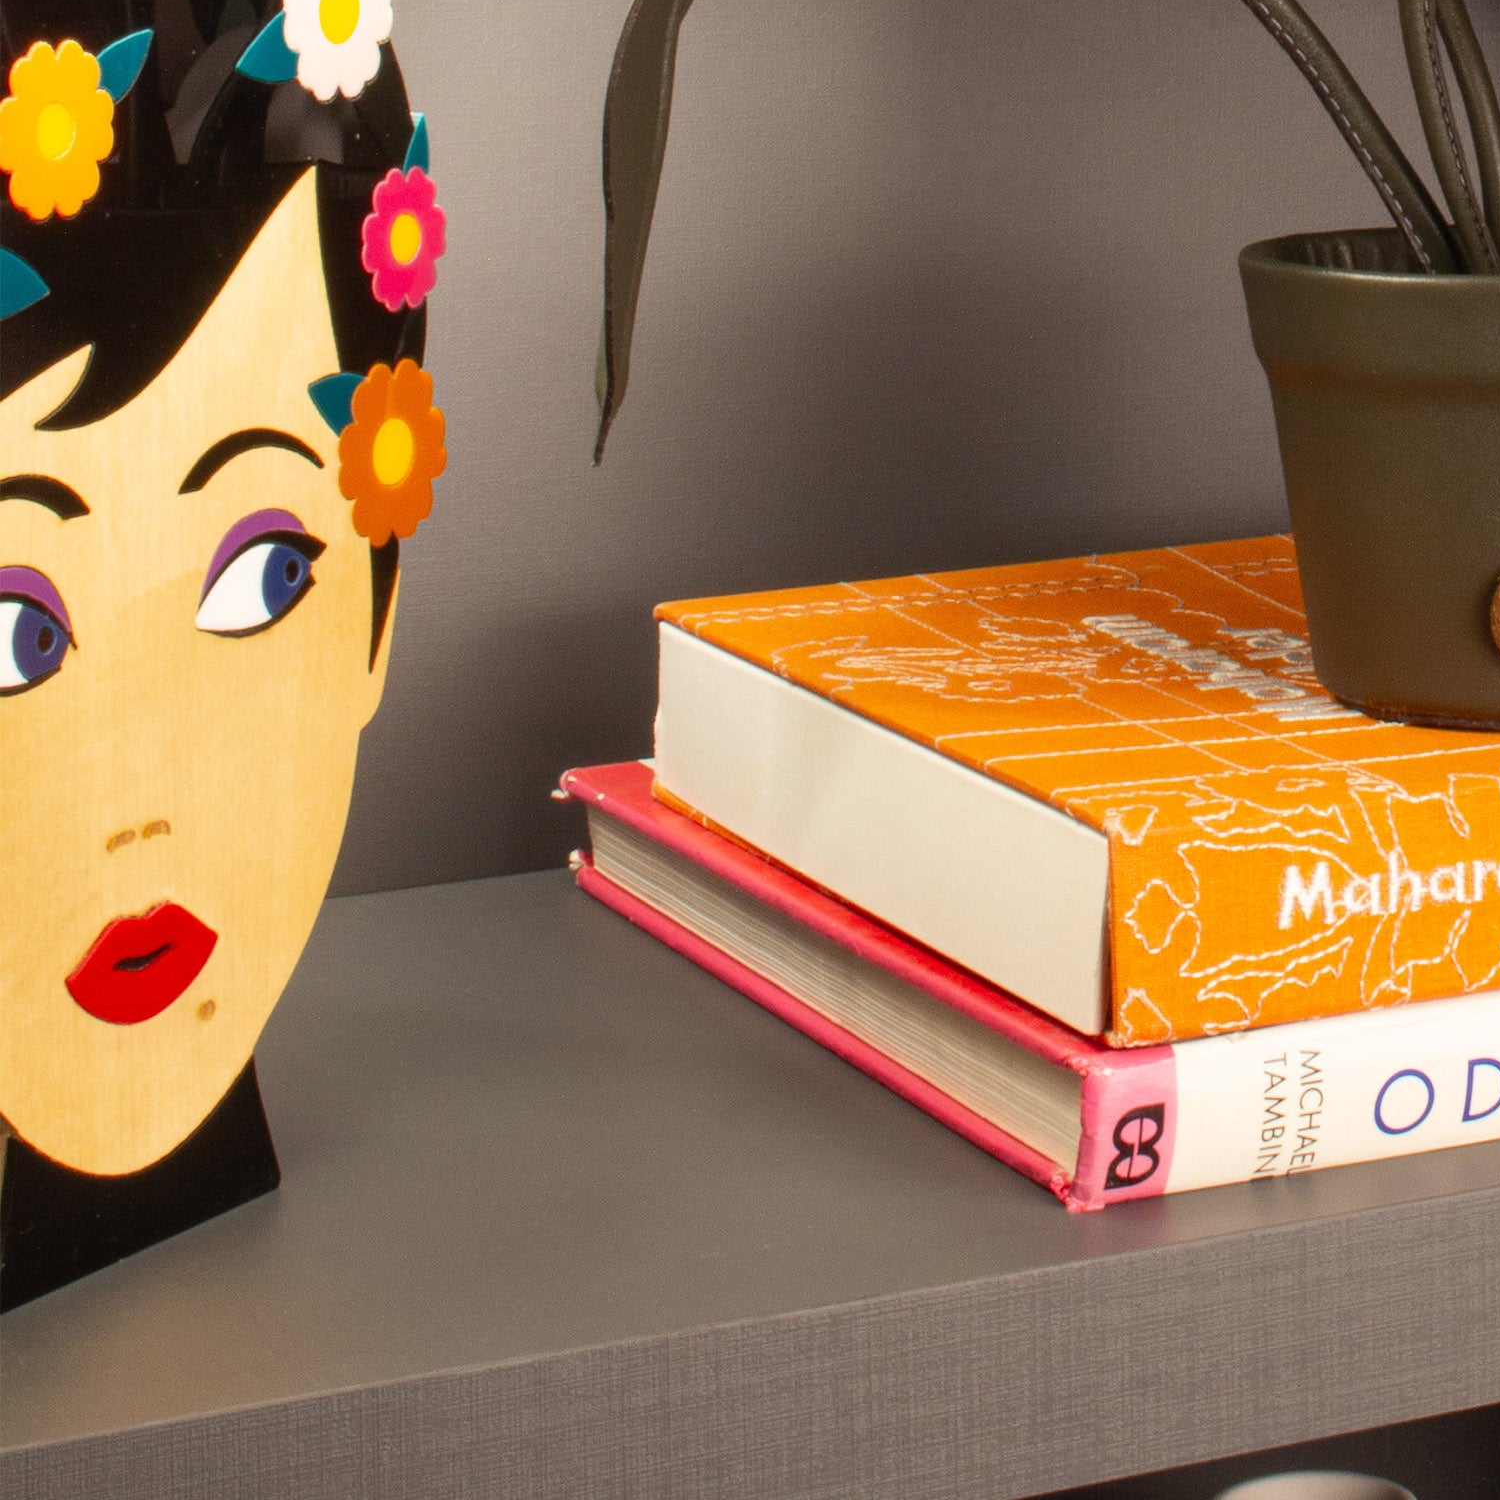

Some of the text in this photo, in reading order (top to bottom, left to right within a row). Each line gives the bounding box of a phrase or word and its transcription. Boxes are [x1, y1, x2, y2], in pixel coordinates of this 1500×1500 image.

[1250, 1051, 1287, 1181] TAMBIN
[1286, 1050, 1324, 1176] MICHAEL
[1374, 1068, 1435, 1135] O
